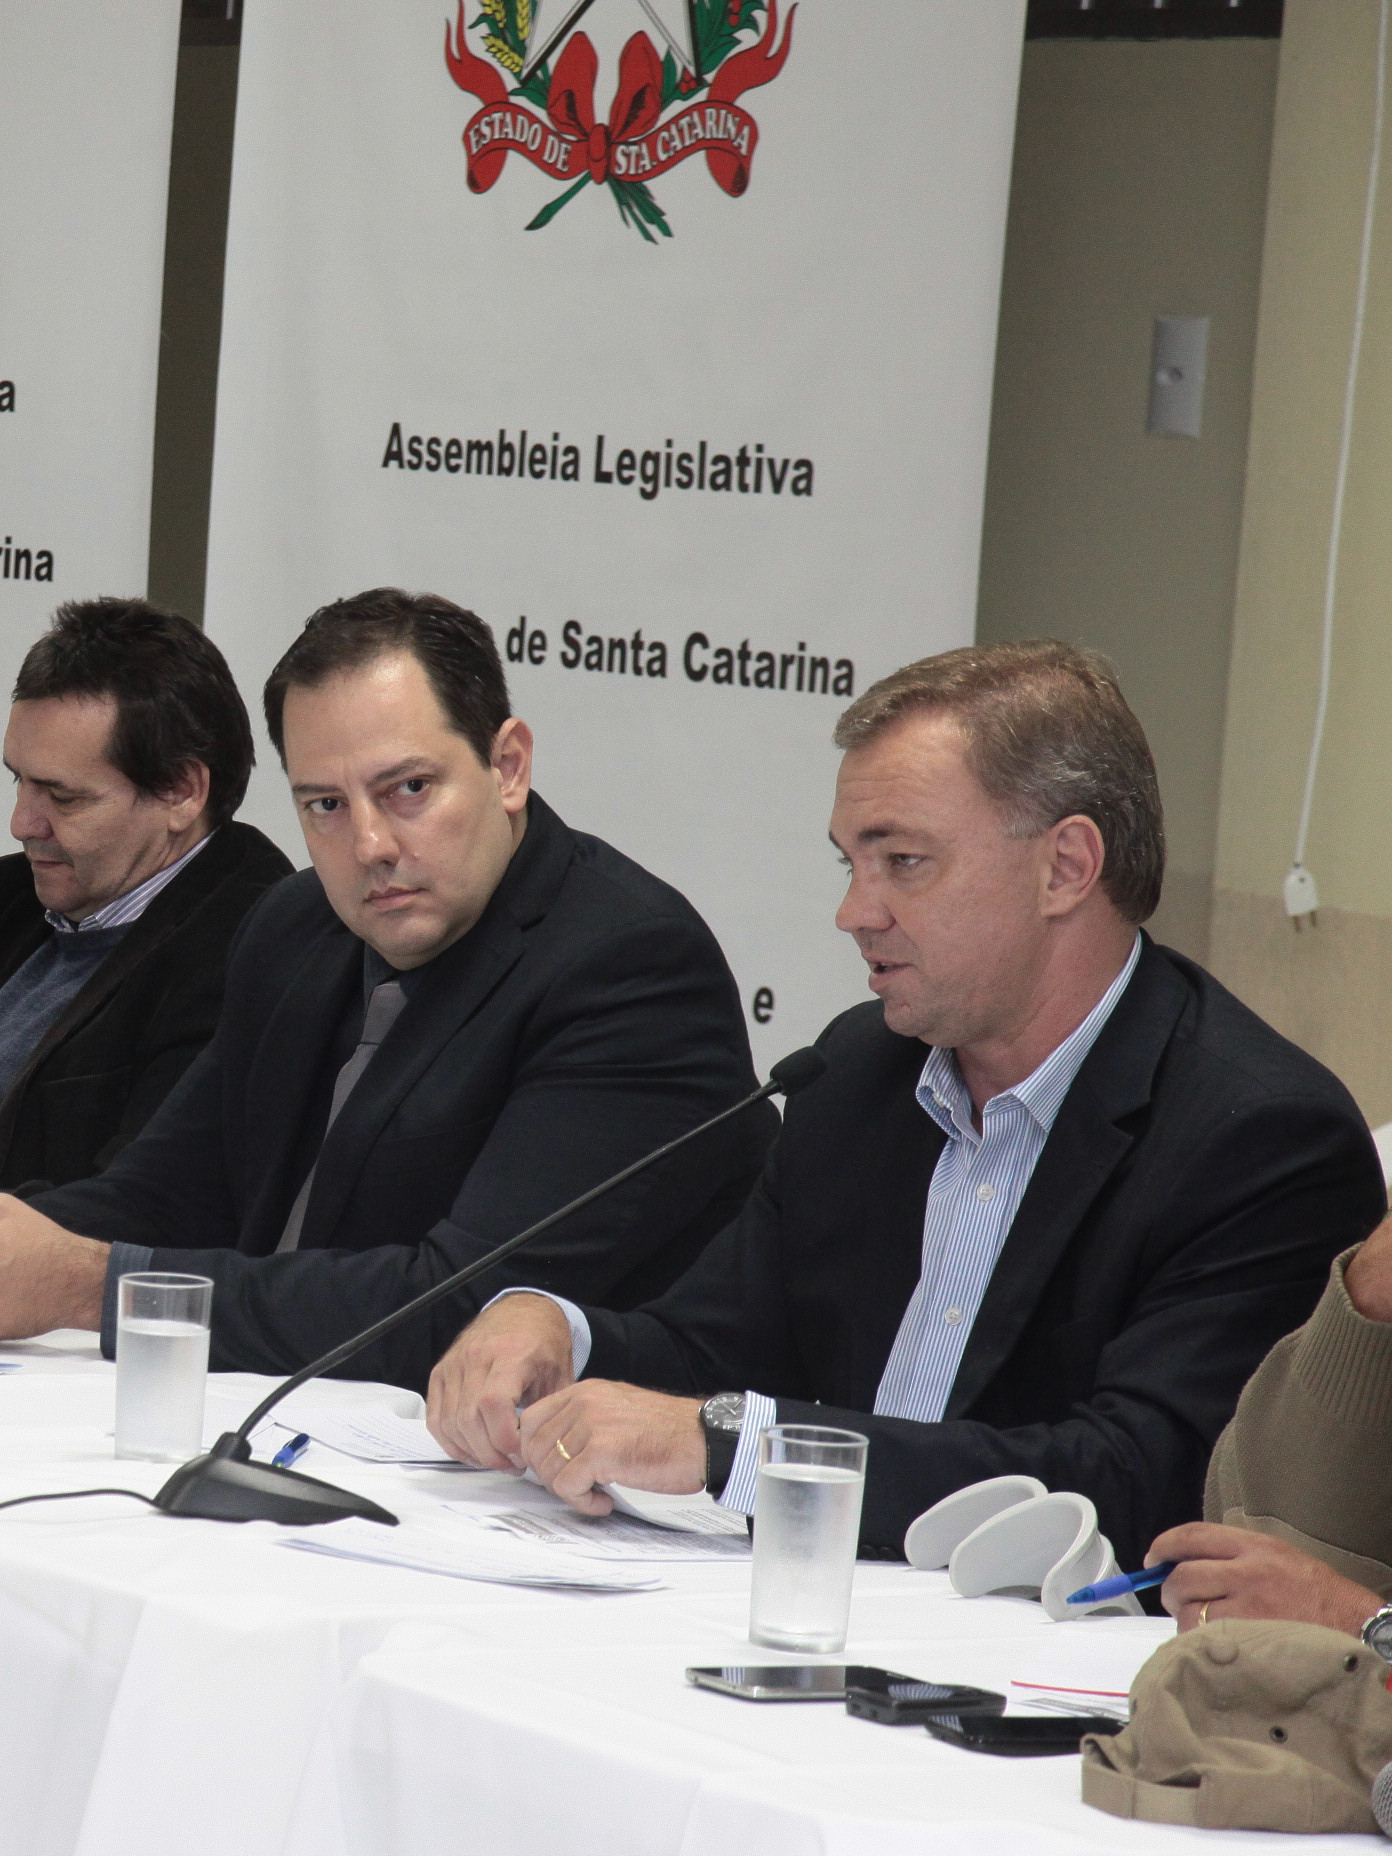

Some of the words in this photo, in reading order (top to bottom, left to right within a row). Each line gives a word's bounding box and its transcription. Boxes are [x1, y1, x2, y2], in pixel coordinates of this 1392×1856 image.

[468, 111, 543, 155] ESTADO
[542, 135, 572, 172] DE
[614, 143, 657, 175] STA.
[657, 108, 750, 161] CATARINA
[381, 422, 580, 482] Assembleia
[593, 434, 814, 501] Legislativa
[505, 615, 548, 666] de
[560, 619, 668, 679] Santa
[683, 631, 855, 697] Catarina
[752, 986, 775, 1025] e
